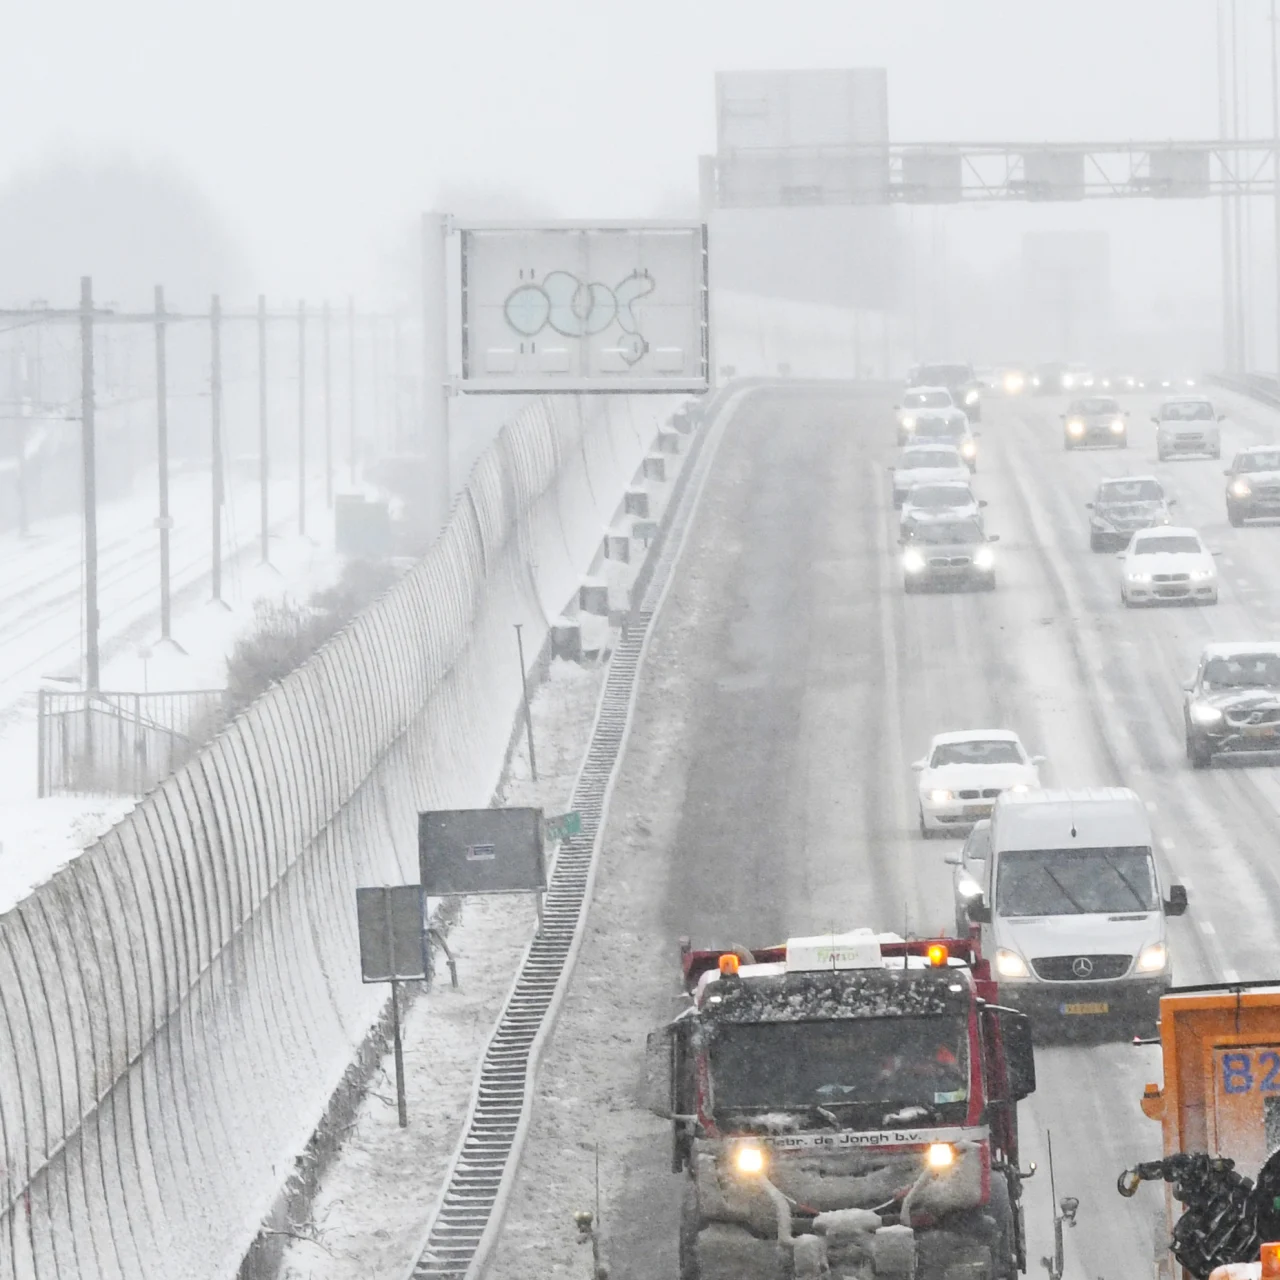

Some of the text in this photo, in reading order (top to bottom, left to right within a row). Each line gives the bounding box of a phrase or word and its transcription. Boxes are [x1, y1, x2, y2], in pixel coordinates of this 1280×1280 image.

[814, 1136, 834, 1145] de
[840, 1133, 888, 1145] Jongh
[895, 1132, 922, 1142] b.v.
